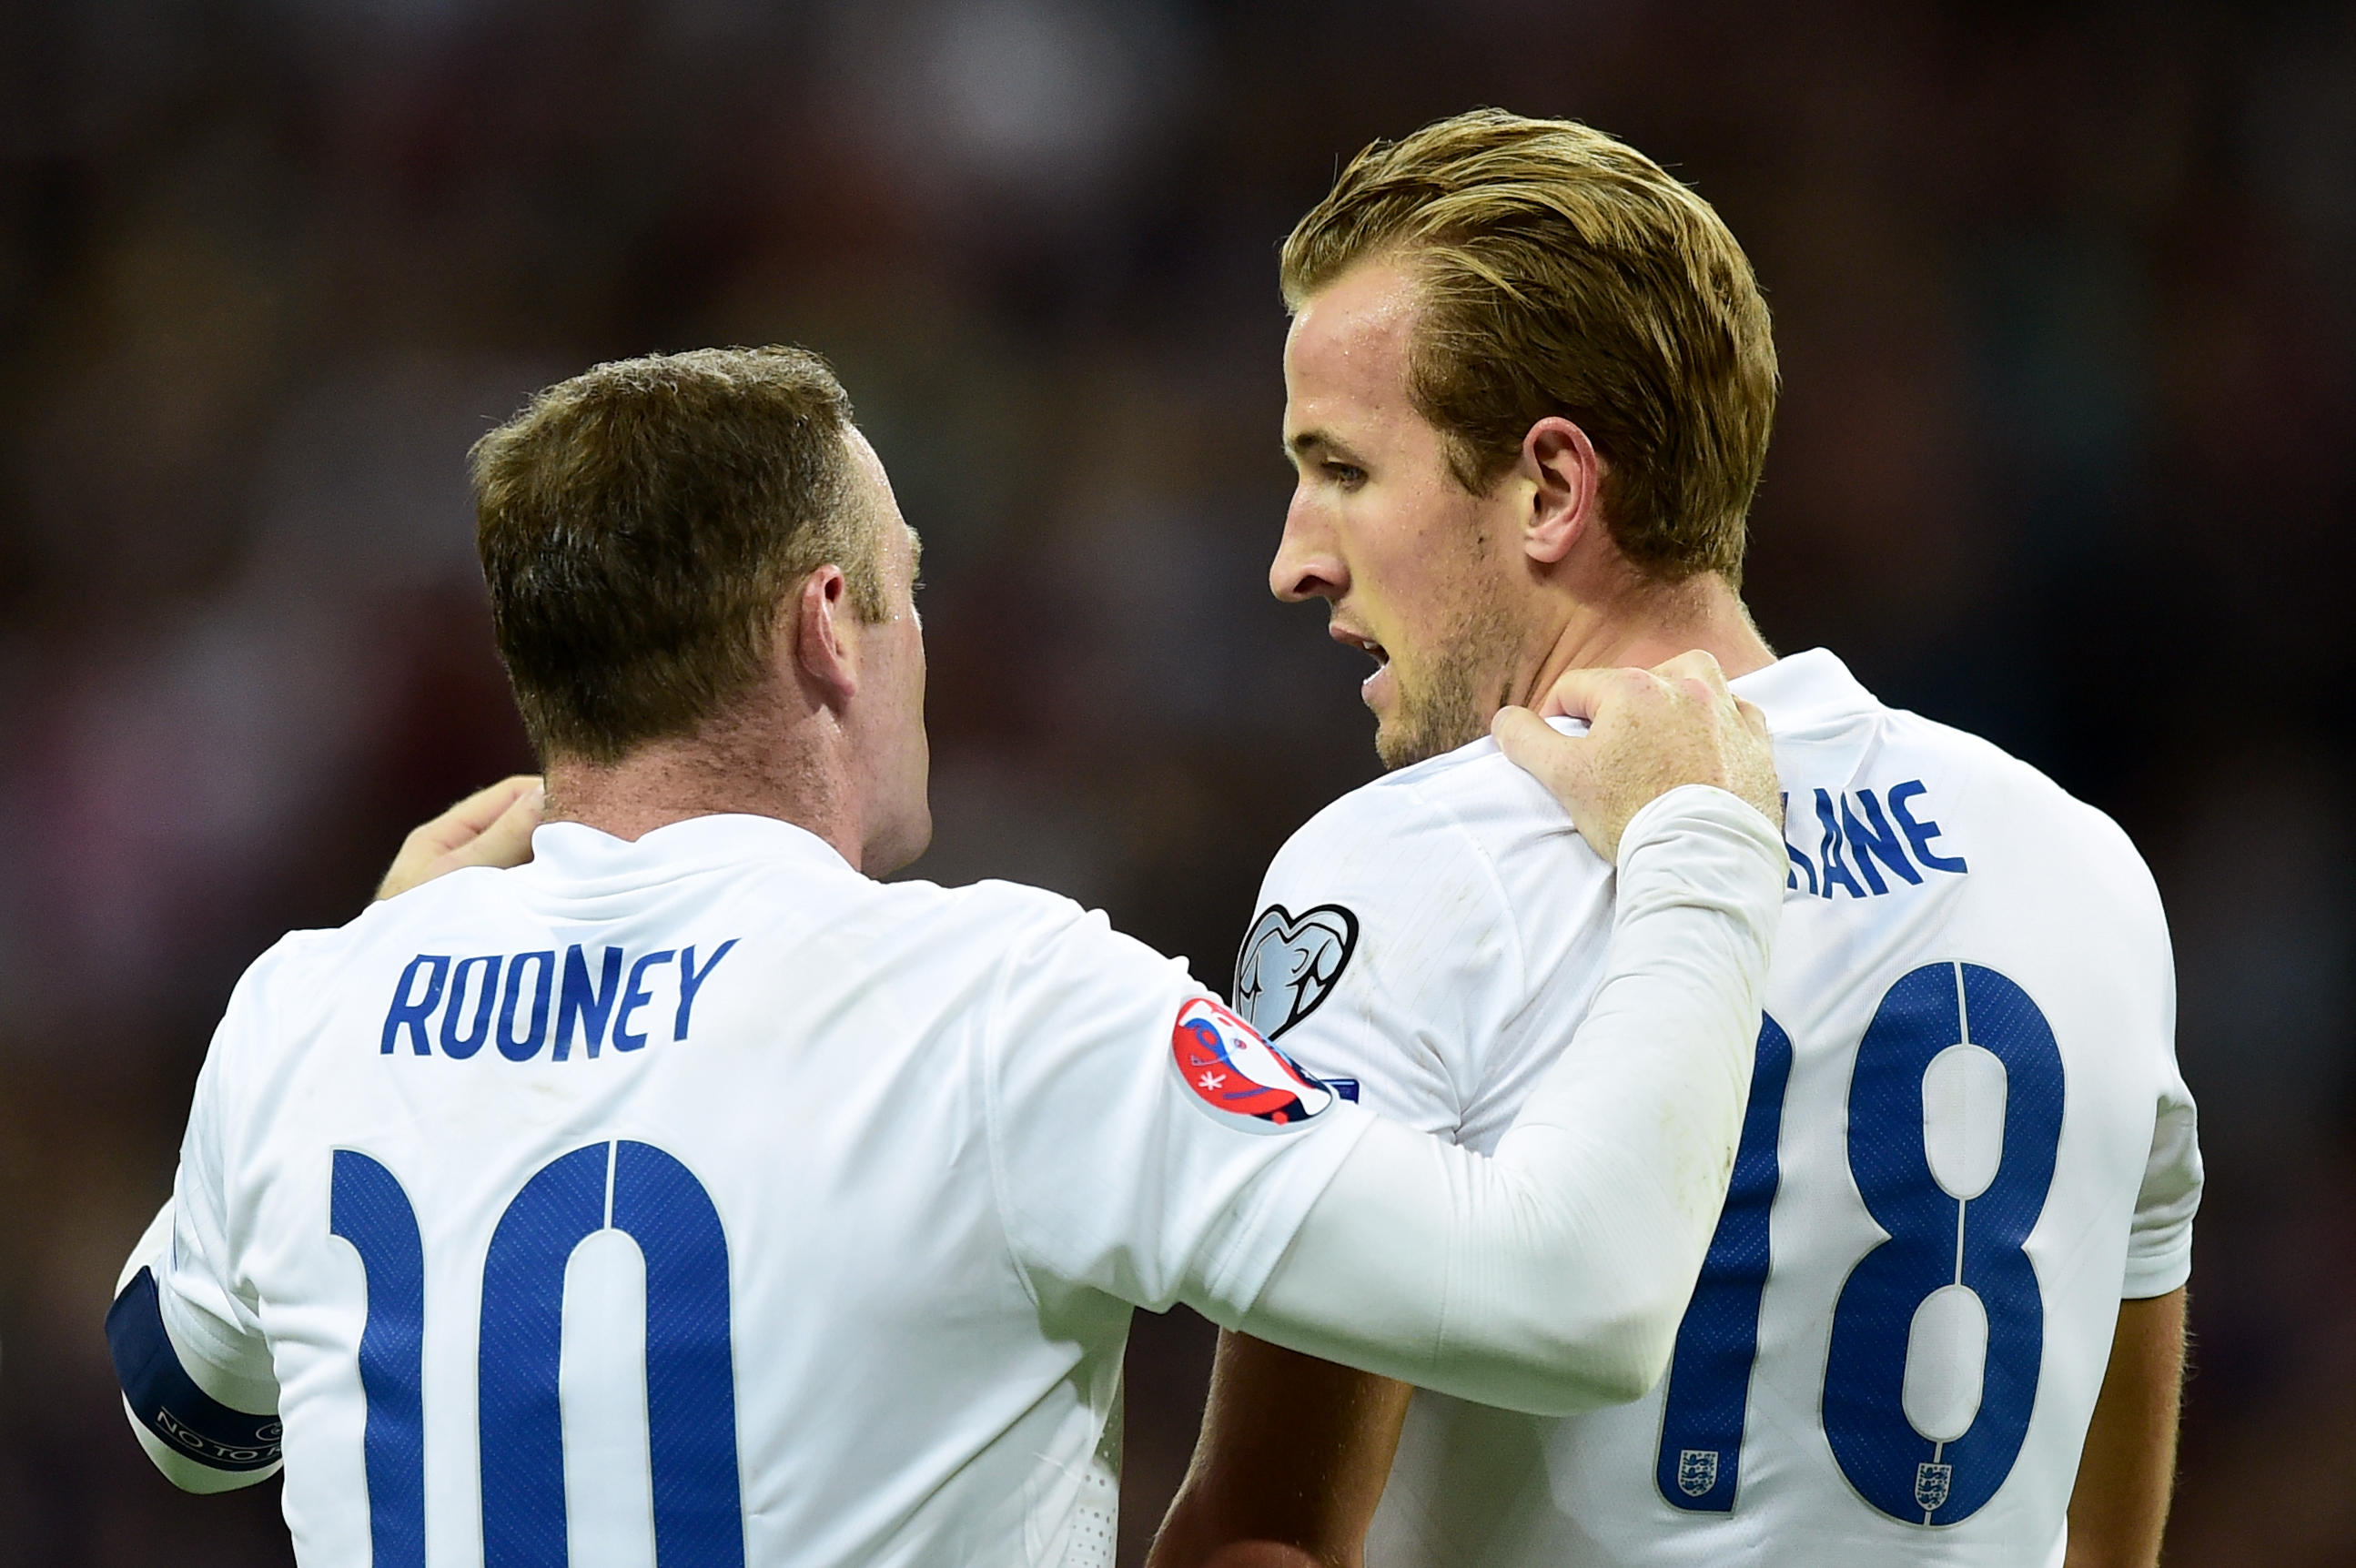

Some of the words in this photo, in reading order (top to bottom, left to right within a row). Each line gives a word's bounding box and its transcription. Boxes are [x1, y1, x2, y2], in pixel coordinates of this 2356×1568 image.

[380, 938, 742, 1062] ROONEY
[330, 1140, 745, 1568] 10
[1655, 961, 2065, 1526] 18
[157, 1411, 204, 1448] NO
[211, 1445, 258, 1461] TO
